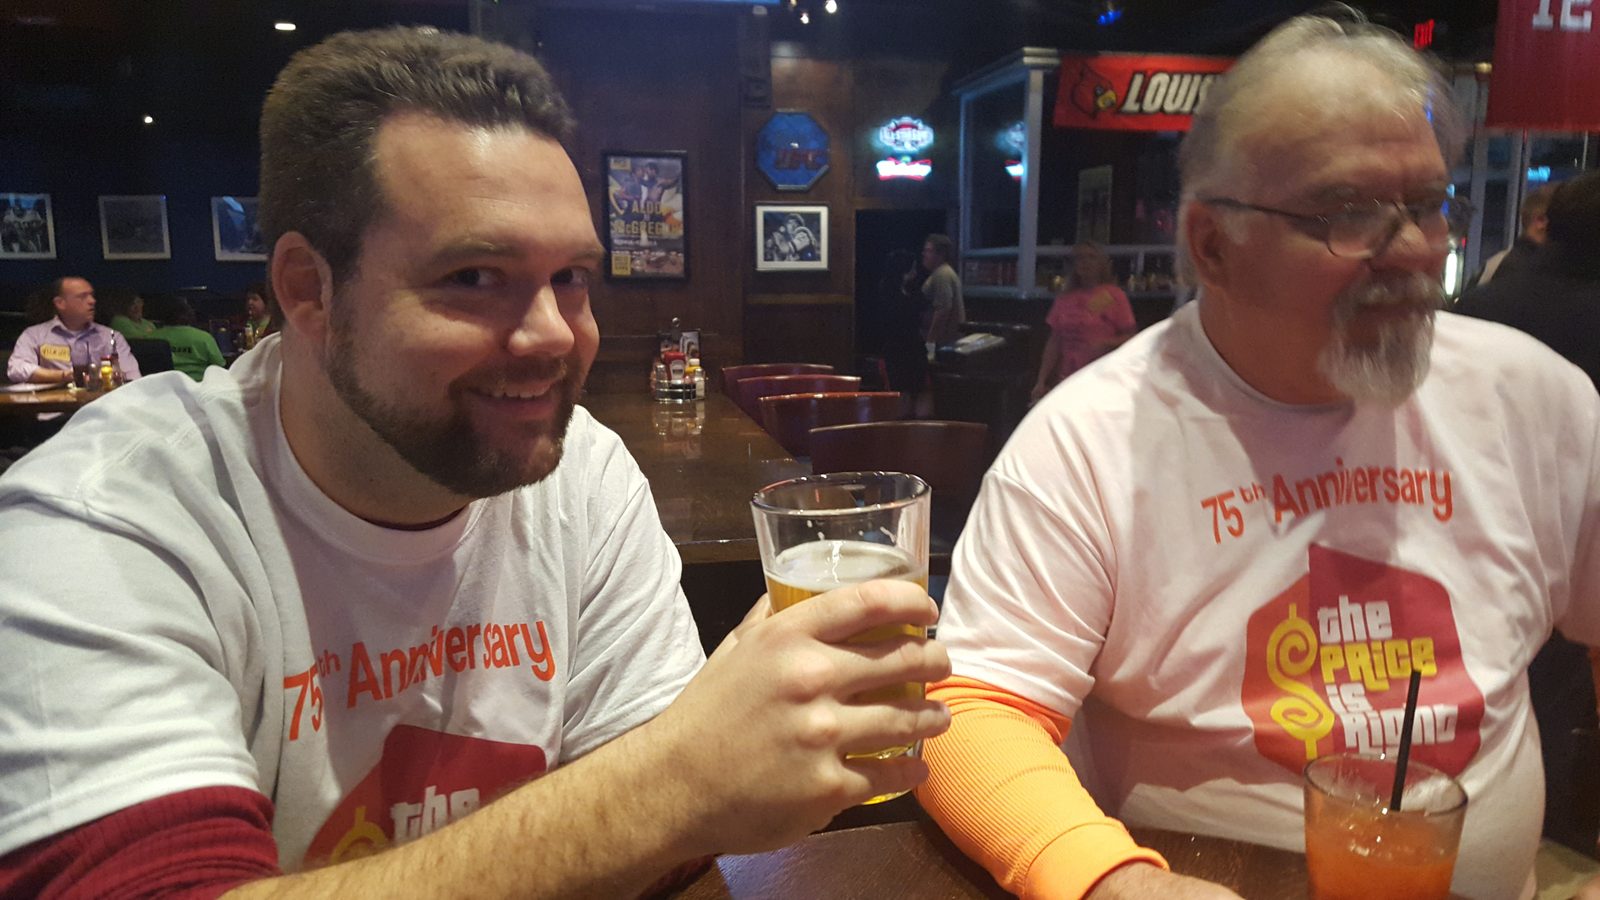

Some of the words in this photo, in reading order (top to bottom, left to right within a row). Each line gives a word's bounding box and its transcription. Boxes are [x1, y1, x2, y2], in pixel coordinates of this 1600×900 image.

[1272, 456, 1453, 523] Anniversary
[1317, 595, 1394, 644] the
[346, 620, 556, 709] Anniversary
